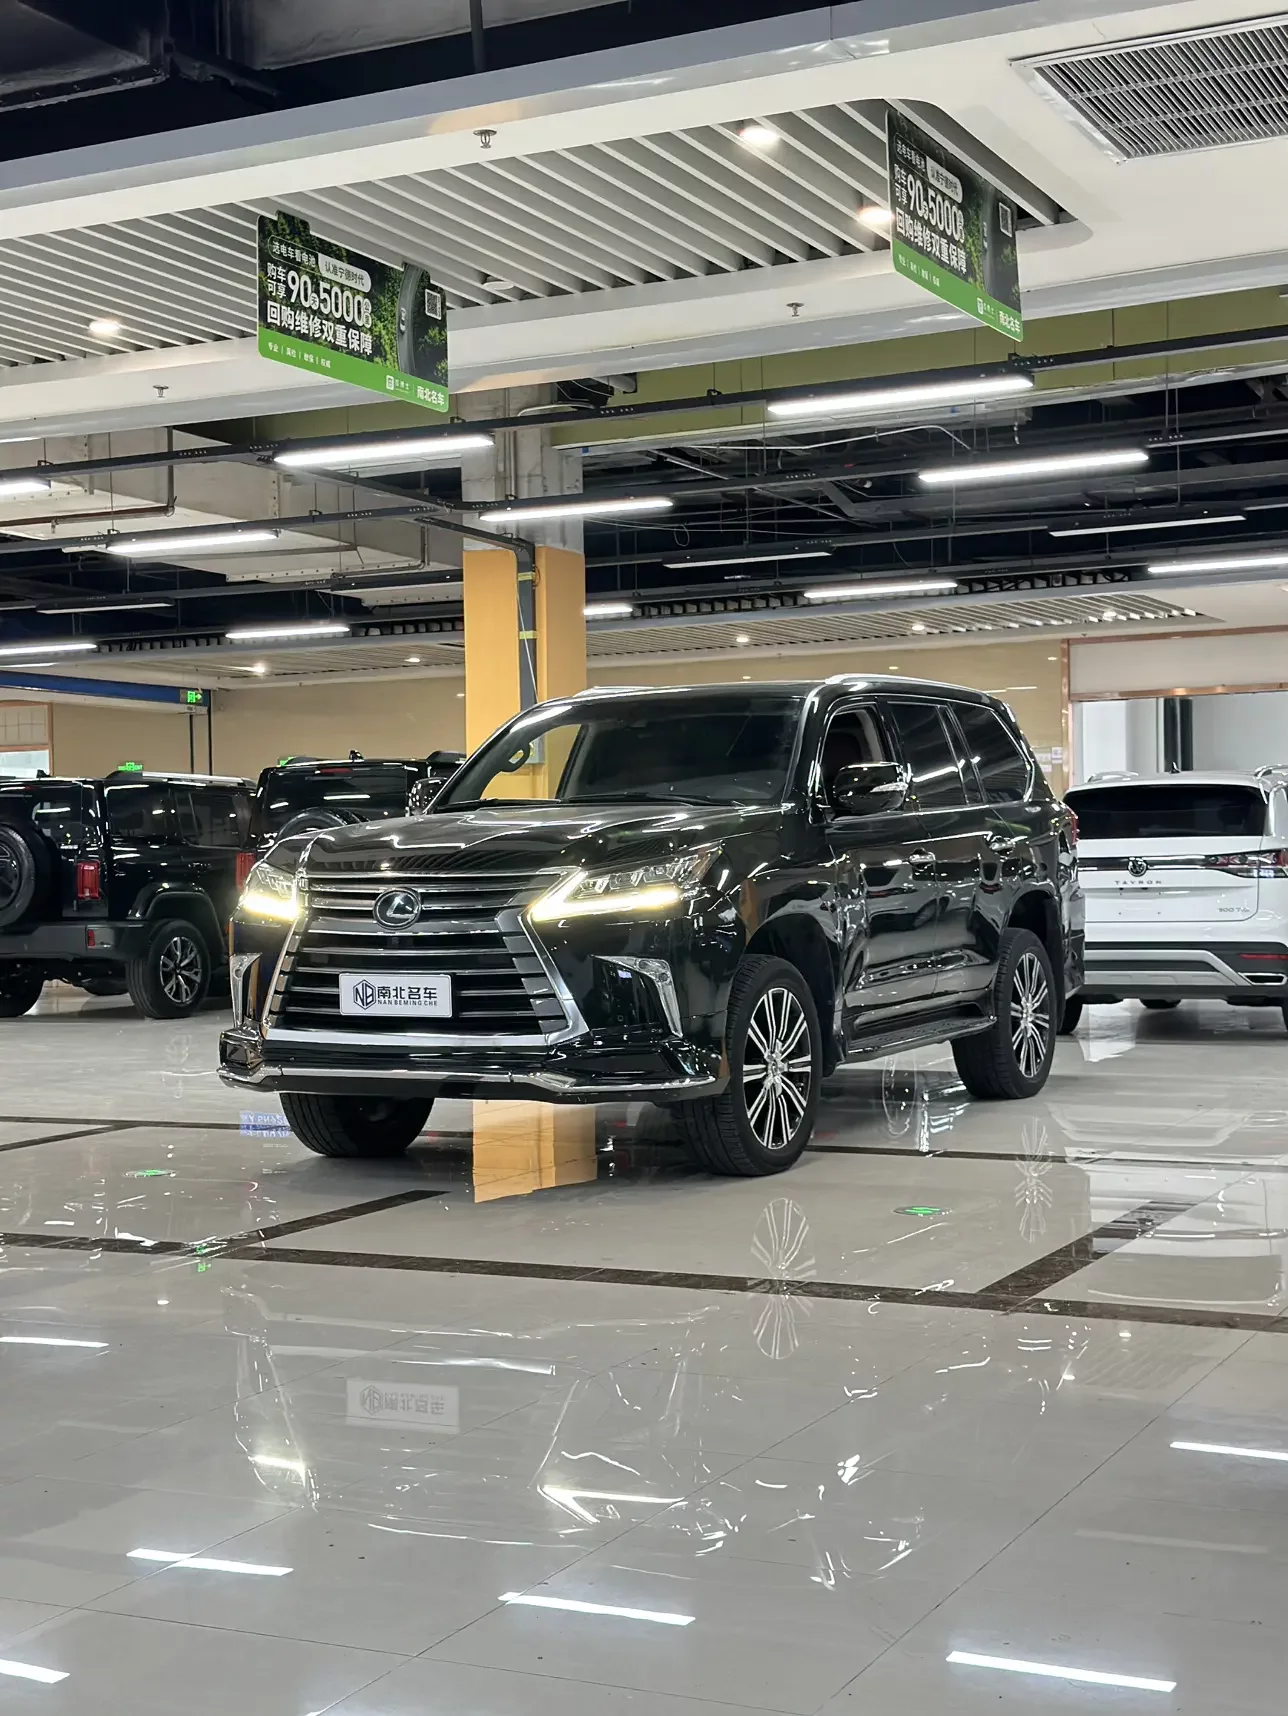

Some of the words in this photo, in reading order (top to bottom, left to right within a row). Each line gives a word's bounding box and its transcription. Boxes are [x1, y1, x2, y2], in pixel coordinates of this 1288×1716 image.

[896, 206, 967, 275] 回购维修双重保障
[272, 241, 316, 268] 选电车看电池
[267, 262, 287, 282] 购车
[324, 261, 365, 287] 认准宁德时代
[267, 280, 287, 299] 可享
[266, 300, 373, 356] 回购维修双重保障
[416, 385, 445, 406] 南北名车
[377, 986, 438, 1000] 南北名车
